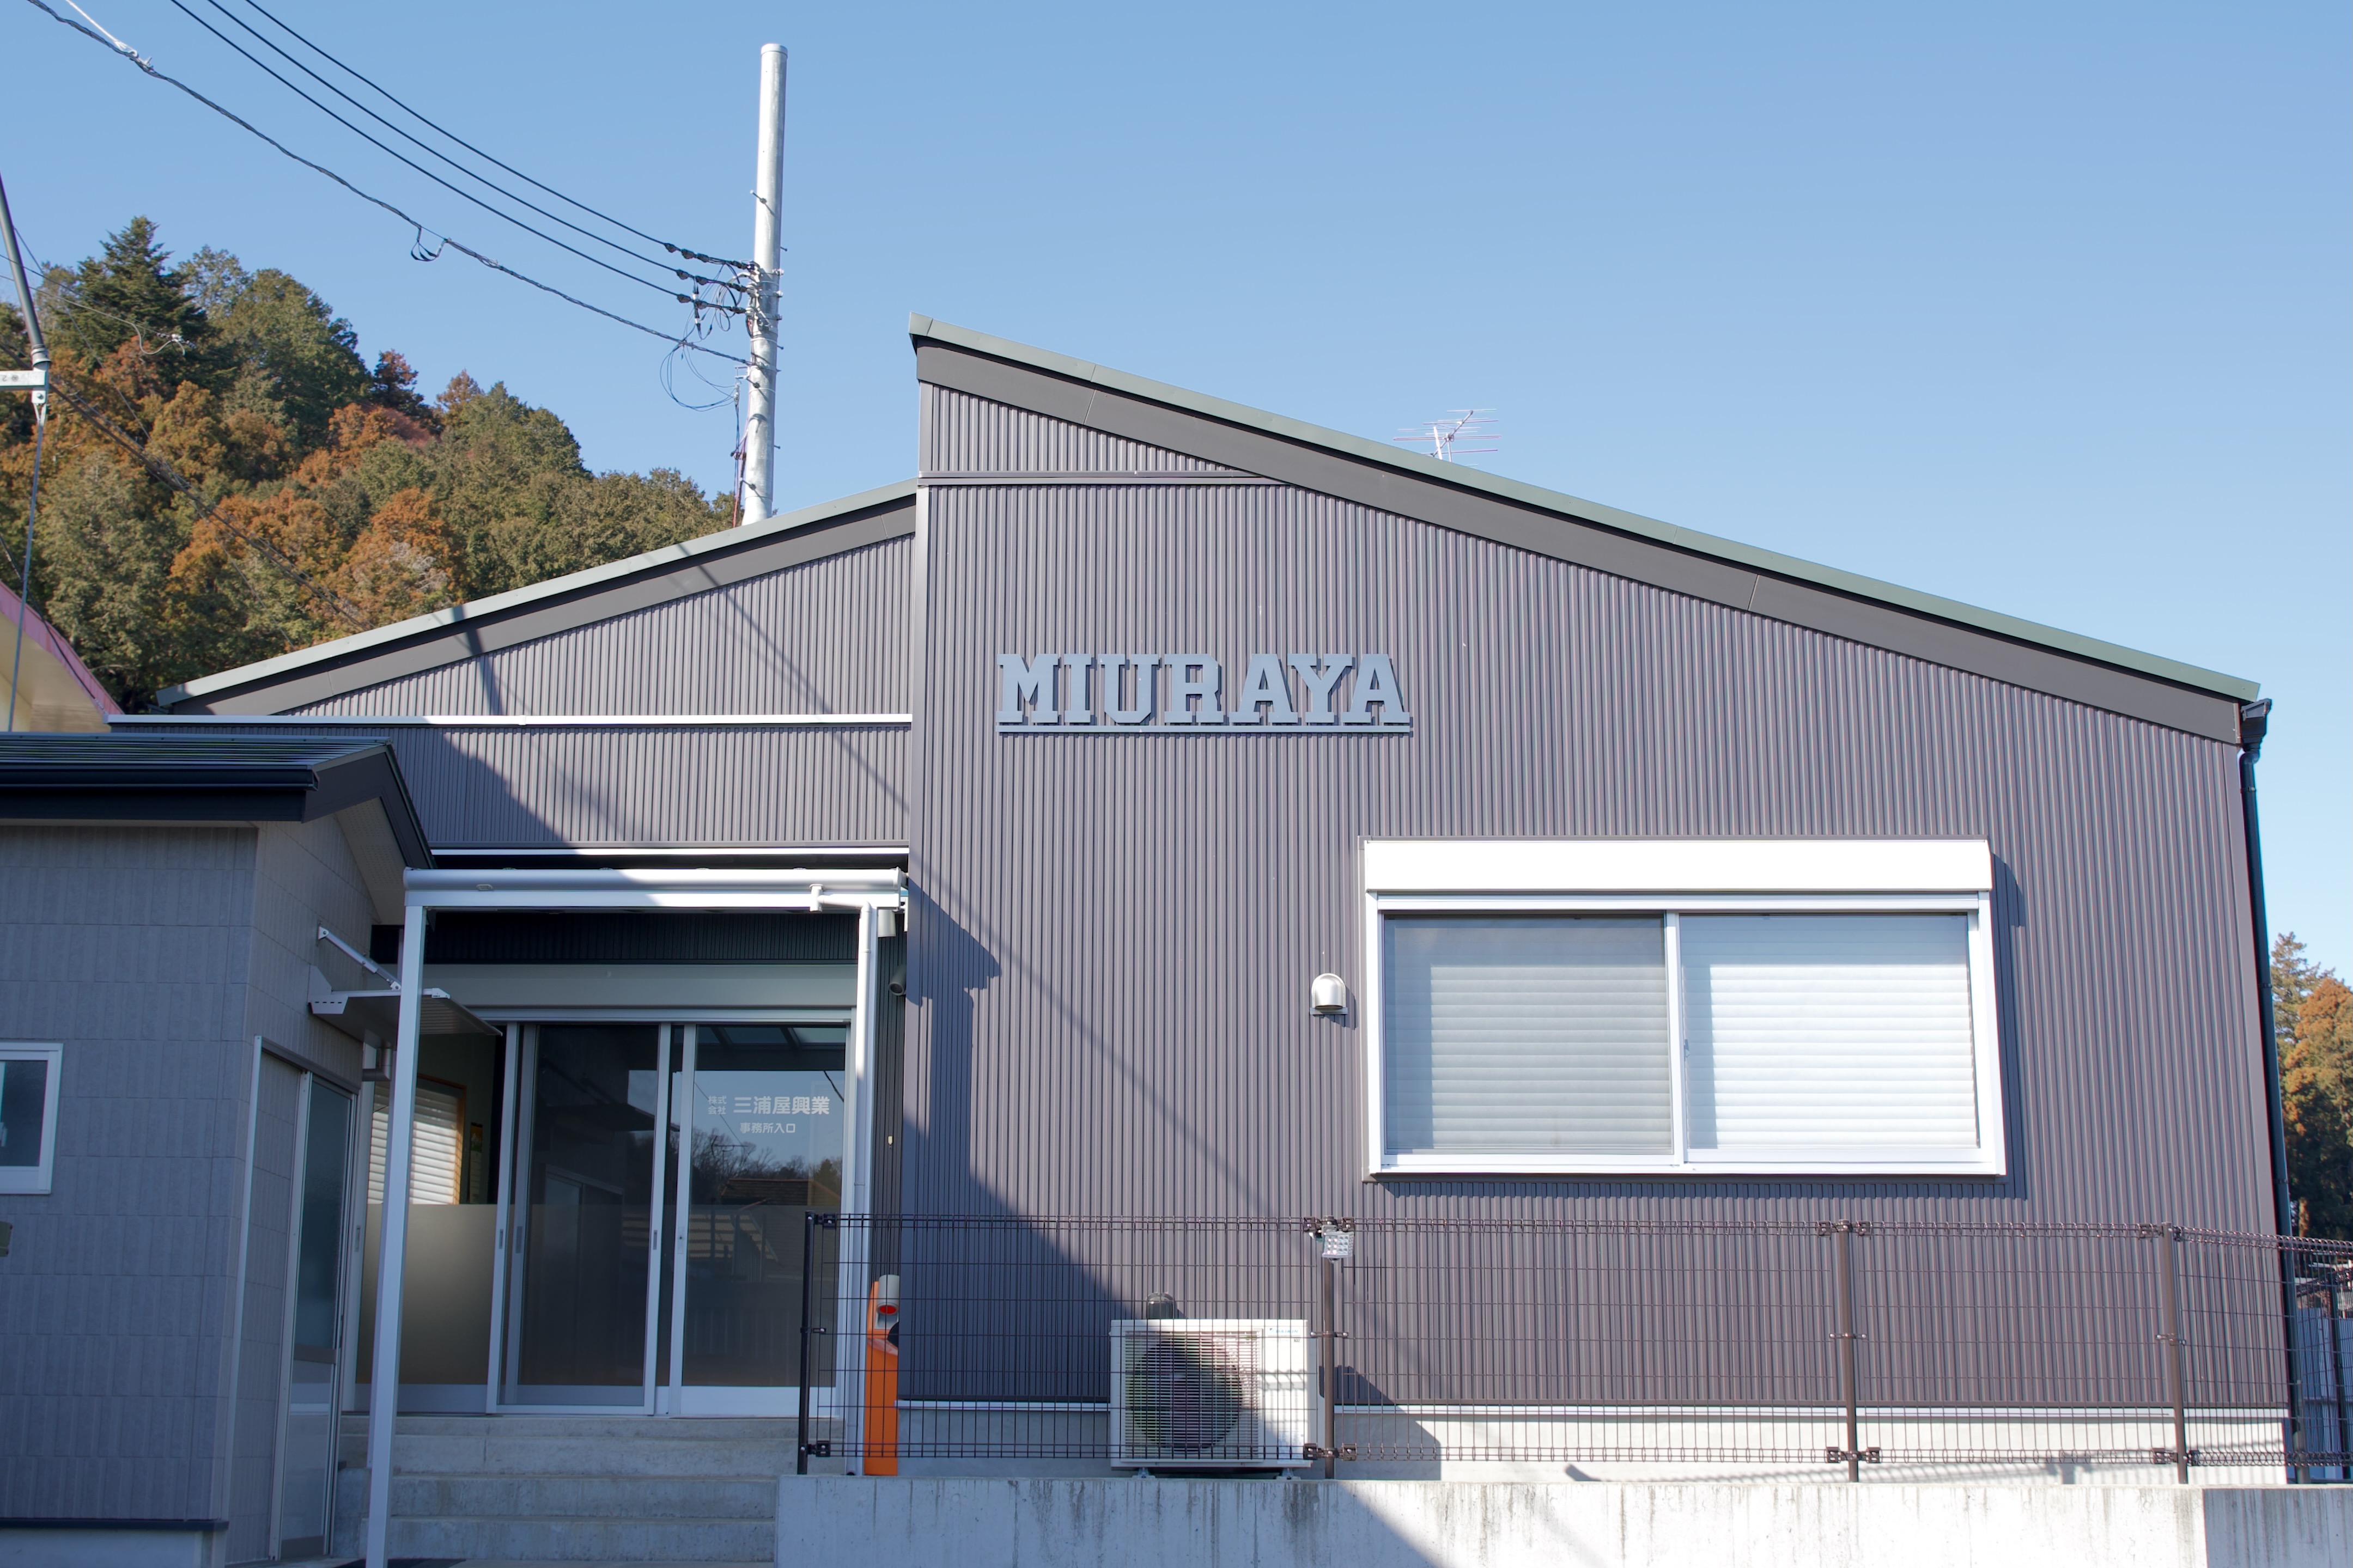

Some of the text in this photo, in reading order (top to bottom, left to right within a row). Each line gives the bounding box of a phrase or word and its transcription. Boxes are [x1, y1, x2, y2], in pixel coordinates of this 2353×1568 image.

[995, 653, 1410, 724] MIURAYA
[708, 1095, 727, 1105] 株式
[733, 1096, 830, 1115] 三浦屋興業
[708, 1106, 727, 1115] 会社
[739, 1122, 796, 1134] 事務所入口
